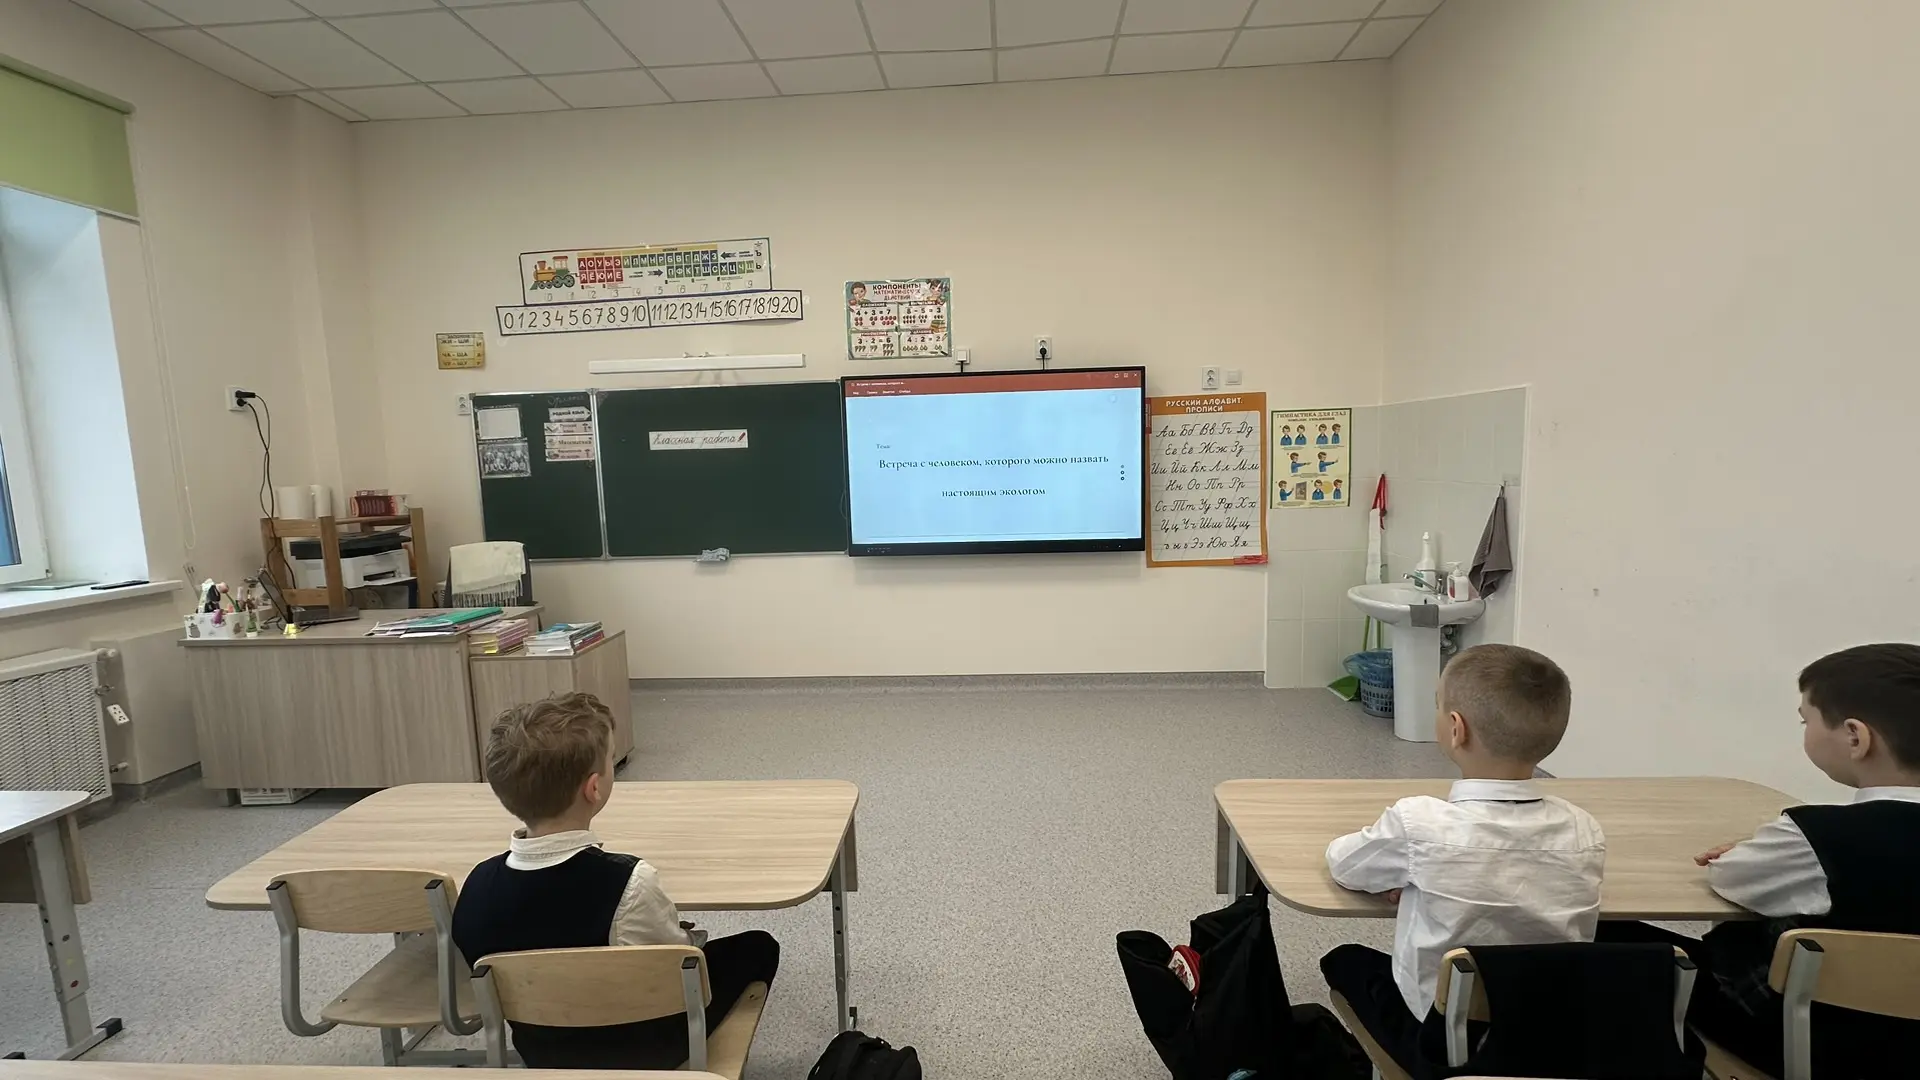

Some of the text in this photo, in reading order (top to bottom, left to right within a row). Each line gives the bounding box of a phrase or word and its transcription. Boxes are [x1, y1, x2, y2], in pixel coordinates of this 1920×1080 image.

[504, 297, 798, 328] 0 1 2 3 4 5 6 7 8 9 10 11 12 13 14 15 16 17 18 19 20
[1166, 398, 1201, 407] РУССКИЙ
[1156, 421, 1253, 438] Аа Бб Вв Гг Дд
[653, 432, 735, 448] Классная работа
[1165, 443, 1177, 455] Ее
[1199, 442, 1228, 453] Жж
[1231, 441, 1244, 457] Зз
[879, 460, 918, 471] Встреча
[985, 458, 1030, 468] которого
[1151, 459, 1259, 474] Ии Йй Кк Лл Мм
[1166, 477, 1245, 492] Нн Оо Пп Рр
[1155, 497, 1256, 514] Сс Тт Уу Фф Хх
[1161, 517, 1250, 533] Цц Чч Шш Щщ
[1191, 537, 1203, 549] Ээ
[1207, 537, 1227, 548] Юю
[1230, 536, 1248, 547] Яя
